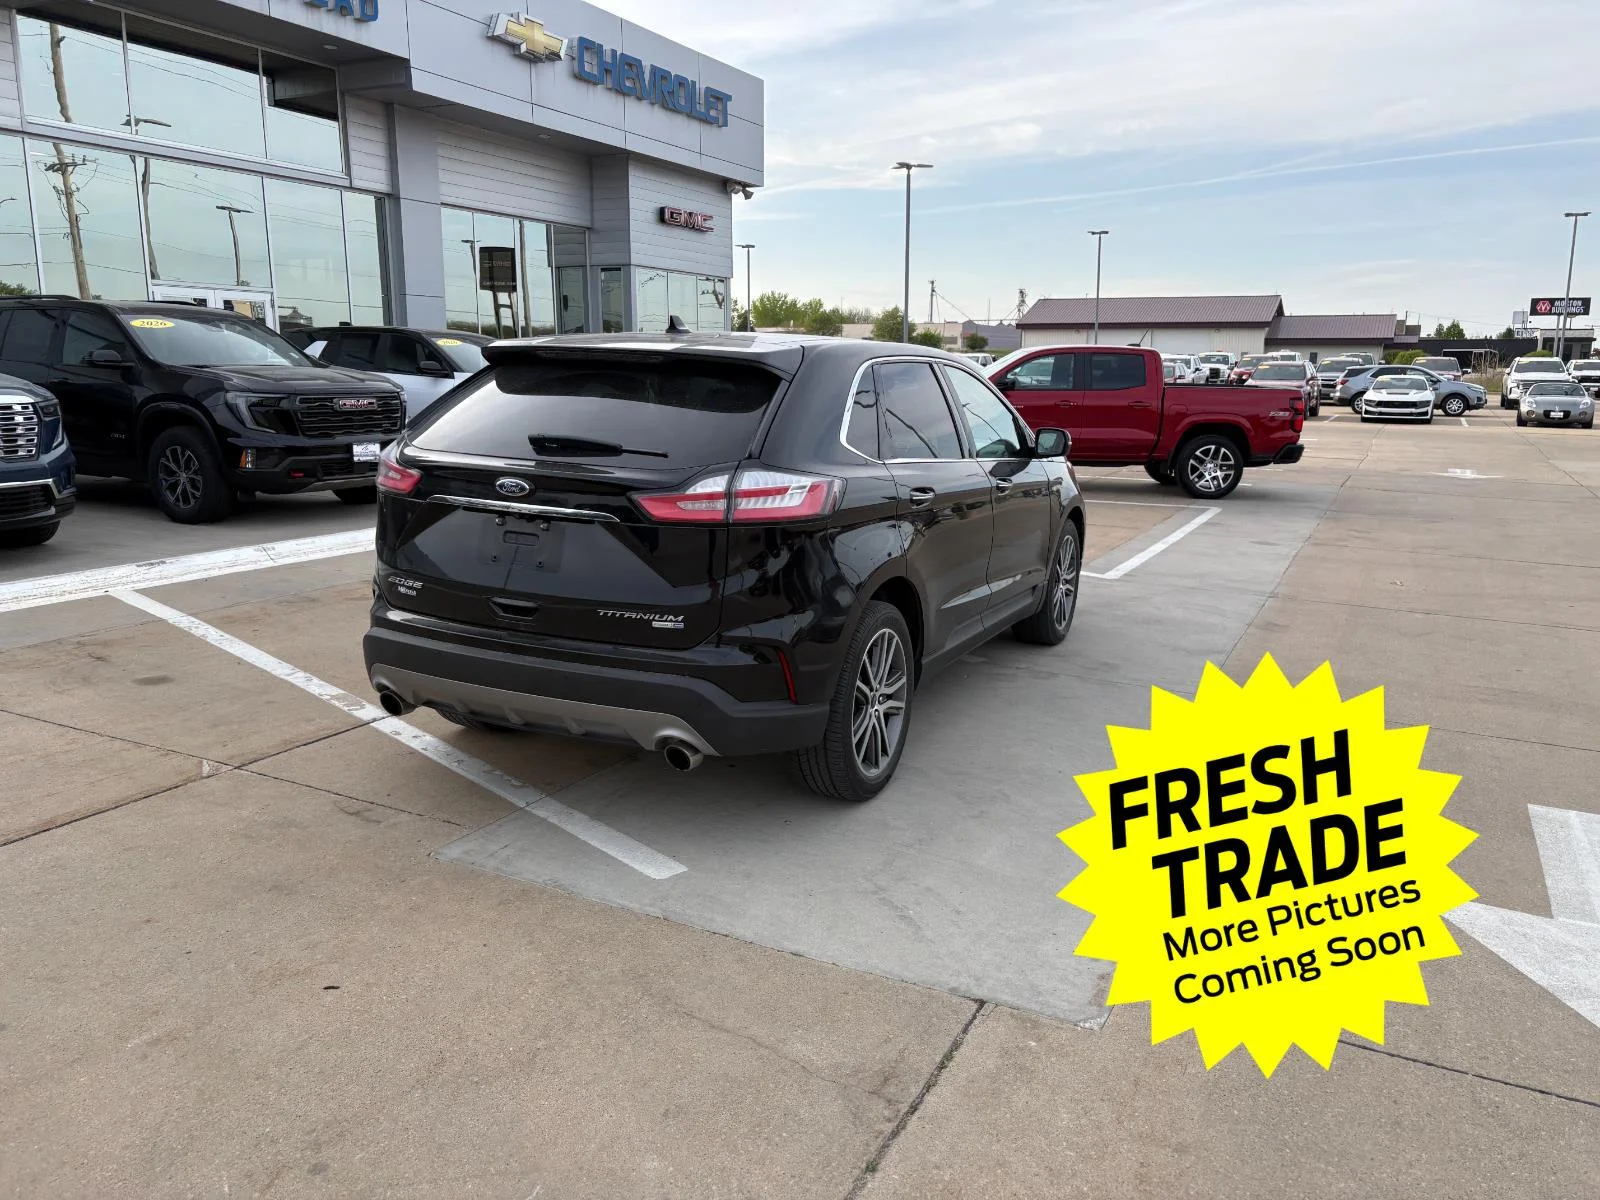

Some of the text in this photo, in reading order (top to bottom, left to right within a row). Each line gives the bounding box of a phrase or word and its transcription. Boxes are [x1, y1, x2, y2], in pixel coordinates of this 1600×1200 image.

[575, 36, 733, 127] CHEVROLET
[663, 206, 715, 232] GMC
[339, 399, 376, 409] GMC
[502, 481, 521, 493] Ford
[388, 576, 424, 589] EDGE
[596, 609, 685, 622] TITANIUM
